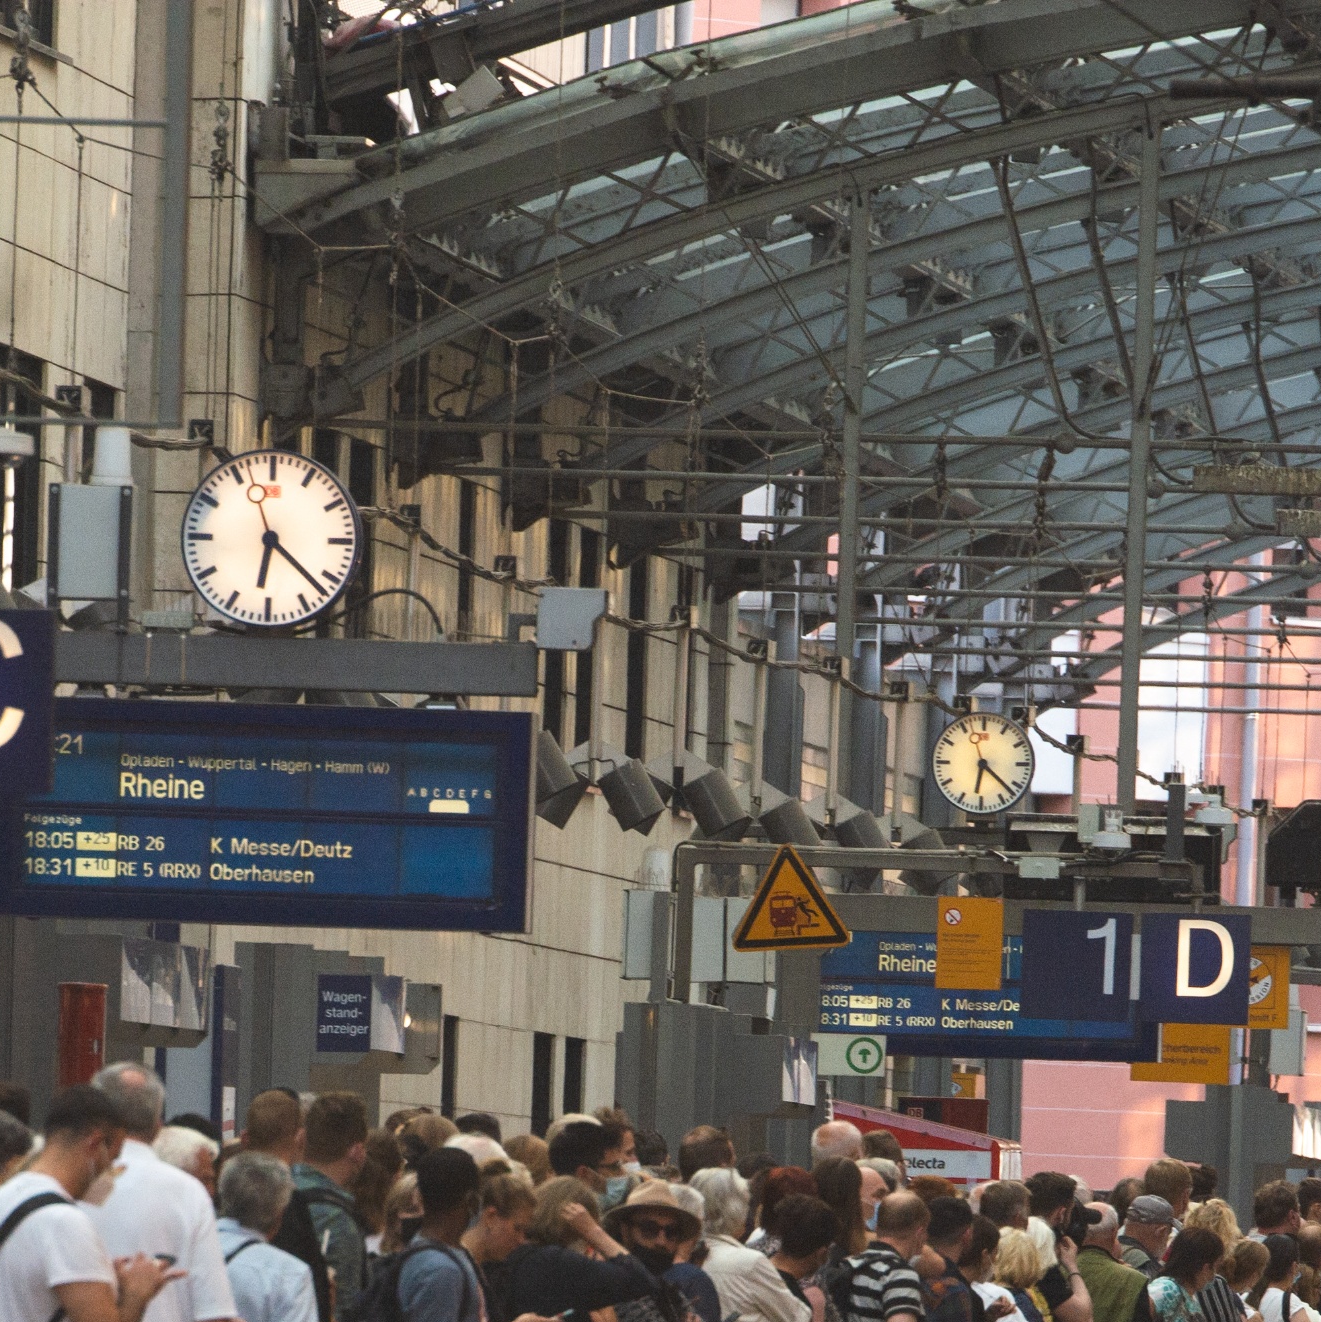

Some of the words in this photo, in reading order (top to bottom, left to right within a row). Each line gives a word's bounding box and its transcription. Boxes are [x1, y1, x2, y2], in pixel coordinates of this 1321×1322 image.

[54, 733, 84, 755] :21
[121, 754, 174, 769] Opladen
[188, 756, 257, 773] Wuppertal
[270, 760, 312, 775] Hagen
[325, 761, 364, 774] Hamm
[367, 761, 390, 775] (W)
[119, 772, 205, 799] Rheine
[24, 813, 83, 827] Folgezüge
[24, 831, 74, 849] 18:05
[84, 833, 111, 845] +25
[118, 835, 140, 851] RB
[145, 836, 165, 851] 26
[211, 837, 223, 854] K
[231, 838, 353, 859] Messe/Deutz
[24, 857, 72, 876] 18:31
[117, 862, 137, 877] RE
[143, 863, 153, 877] 5
[159, 863, 201, 879] (RRX)
[210, 863, 315, 884] Oberhausen
[879, 942, 917, 952] Opladen
[878, 954, 936, 973] Rheine
[1086, 918, 1117, 995] 1
[1176, 919, 1235, 998] D
[821, 984, 854, 992] lgezüge
[321, 991, 367, 1005] Wagen-
[821, 995, 849, 1008] 8:05
[878, 998, 893, 1009] RB
[896, 998, 912, 1009] 26
[941, 999, 951, 1011] K
[956, 999, 1020, 1012] Messe/De
[325, 1007, 363, 1018] stand-
[319, 1023, 369, 1037] anzeiger
[820, 1013, 847, 1026] 8:31
[878, 1015, 891, 1027] RE
[895, 1016, 903, 1027] 5
[906, 1016, 936, 1028] (RRX)
[941, 1016, 1014, 1030] Oberhausen
[906, 1158, 946, 1169] electa
